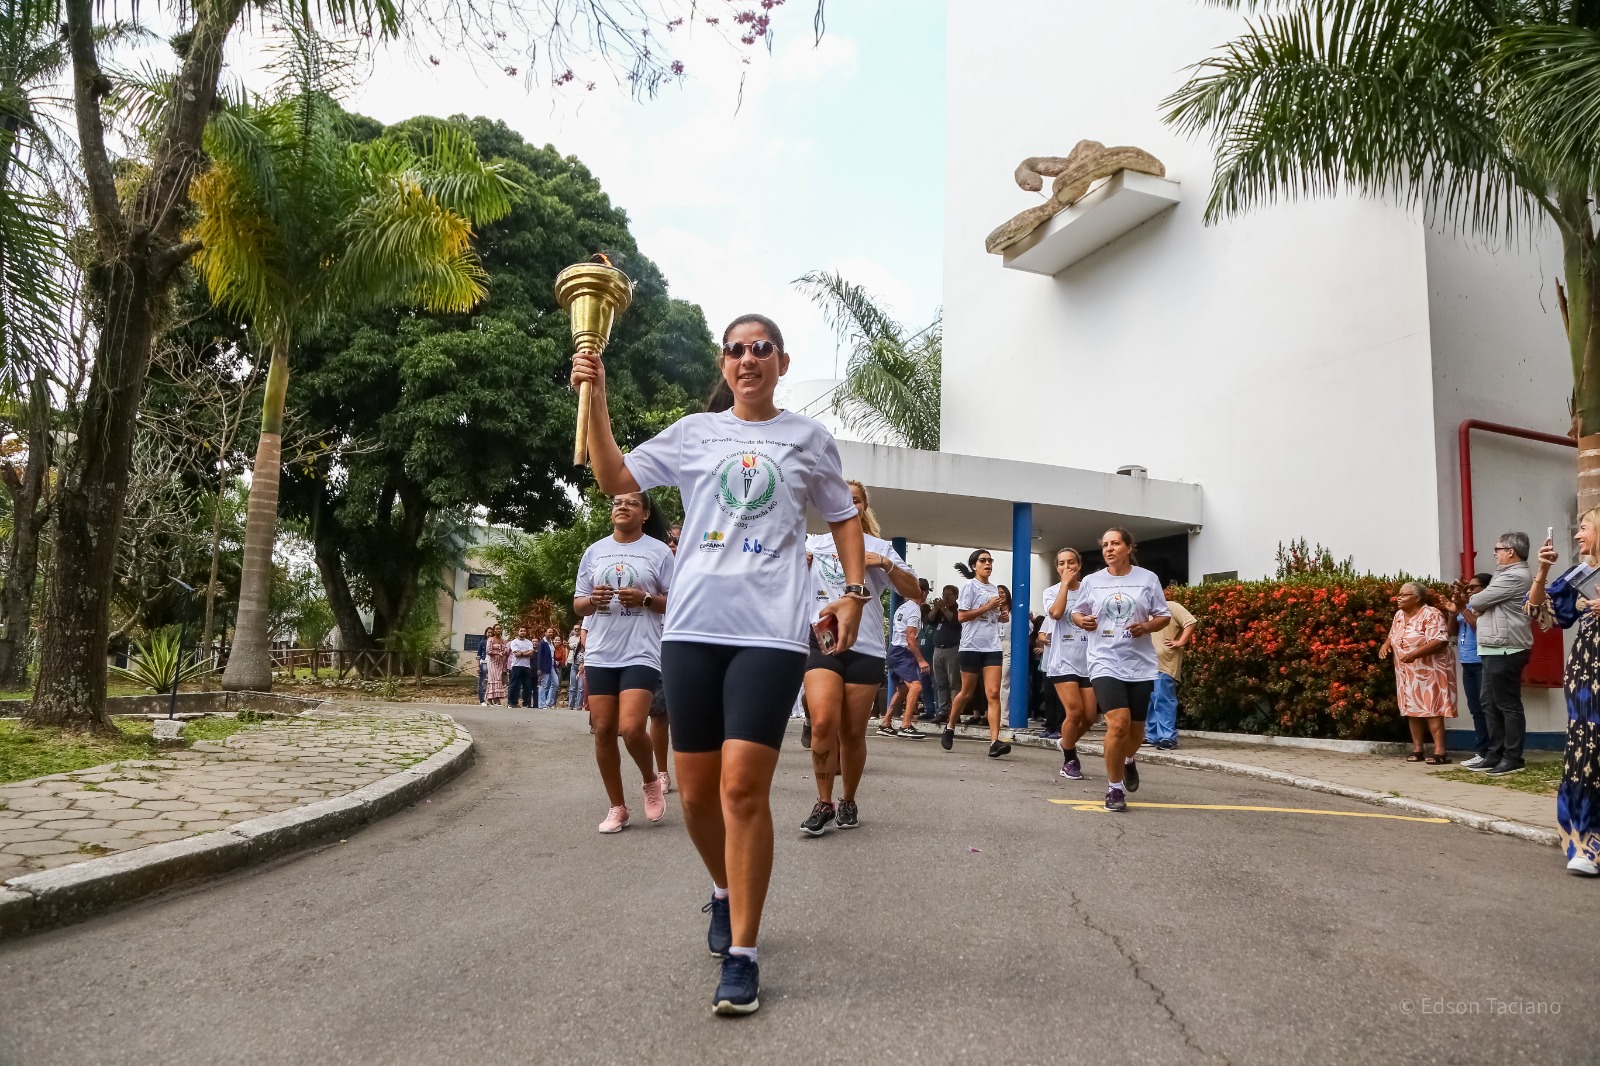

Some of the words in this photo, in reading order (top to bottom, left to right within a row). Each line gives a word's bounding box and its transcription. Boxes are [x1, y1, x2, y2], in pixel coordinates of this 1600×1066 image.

[740, 509, 769, 521] Campanha
[767, 500, 778, 512] MG
[733, 521, 749, 530] 2025
